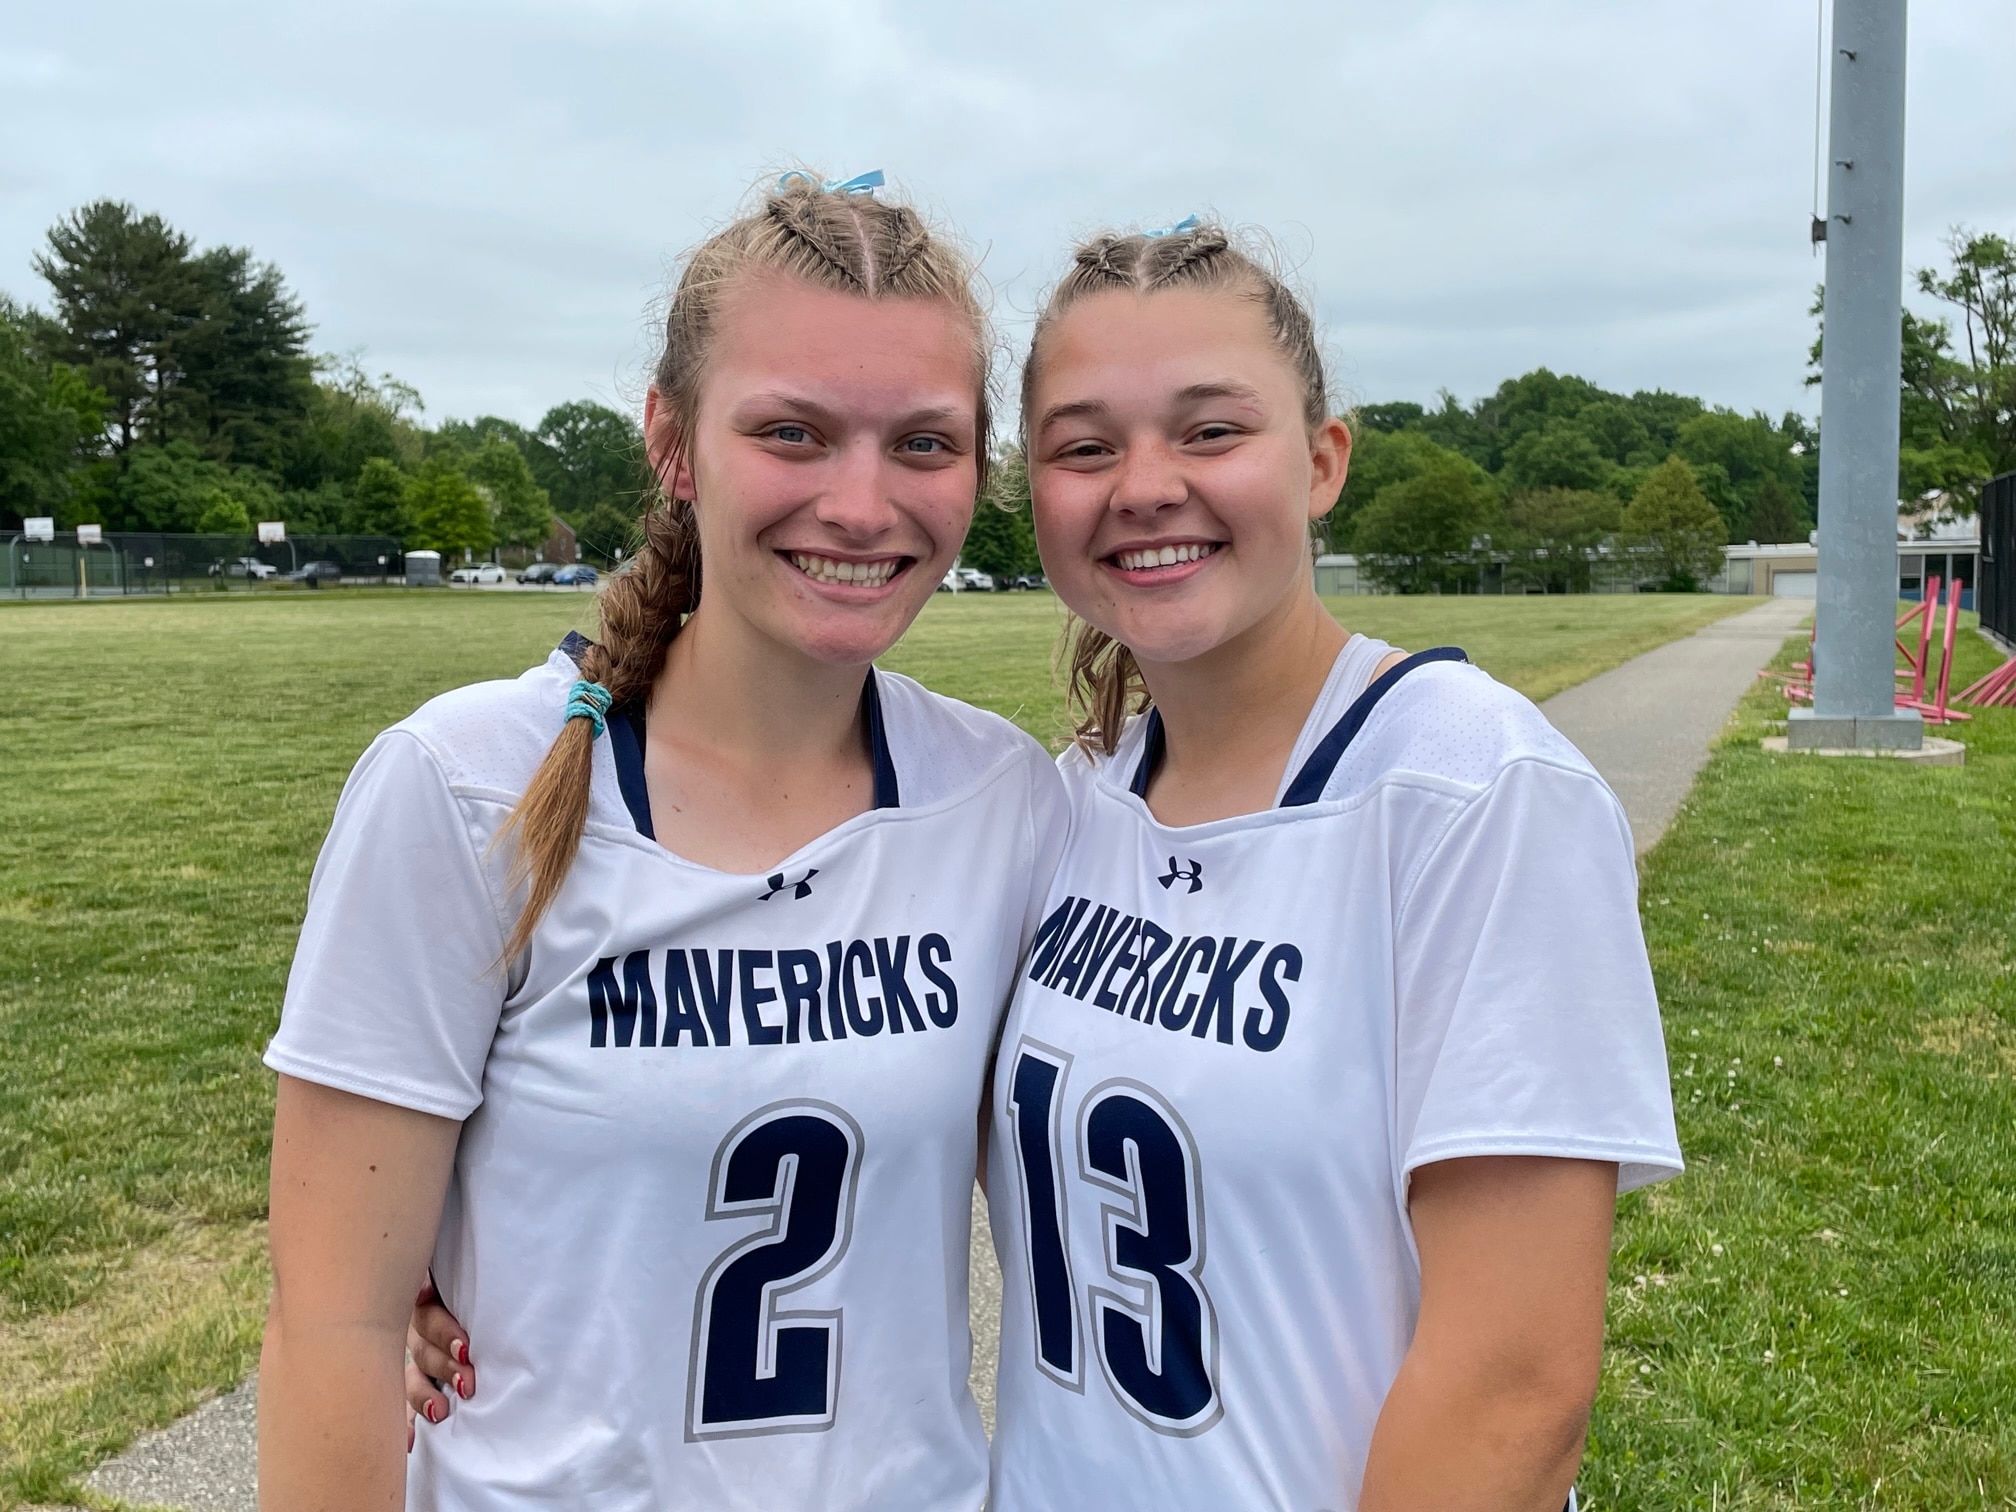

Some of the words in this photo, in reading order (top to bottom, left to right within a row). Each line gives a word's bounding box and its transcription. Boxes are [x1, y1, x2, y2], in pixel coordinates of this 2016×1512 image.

[587, 932, 959, 1049] MAVERICKS
[1028, 895, 1304, 1053] MAVERICKS
[684, 1097, 865, 1443] 2
[1007, 1034, 1225, 1439] 13
